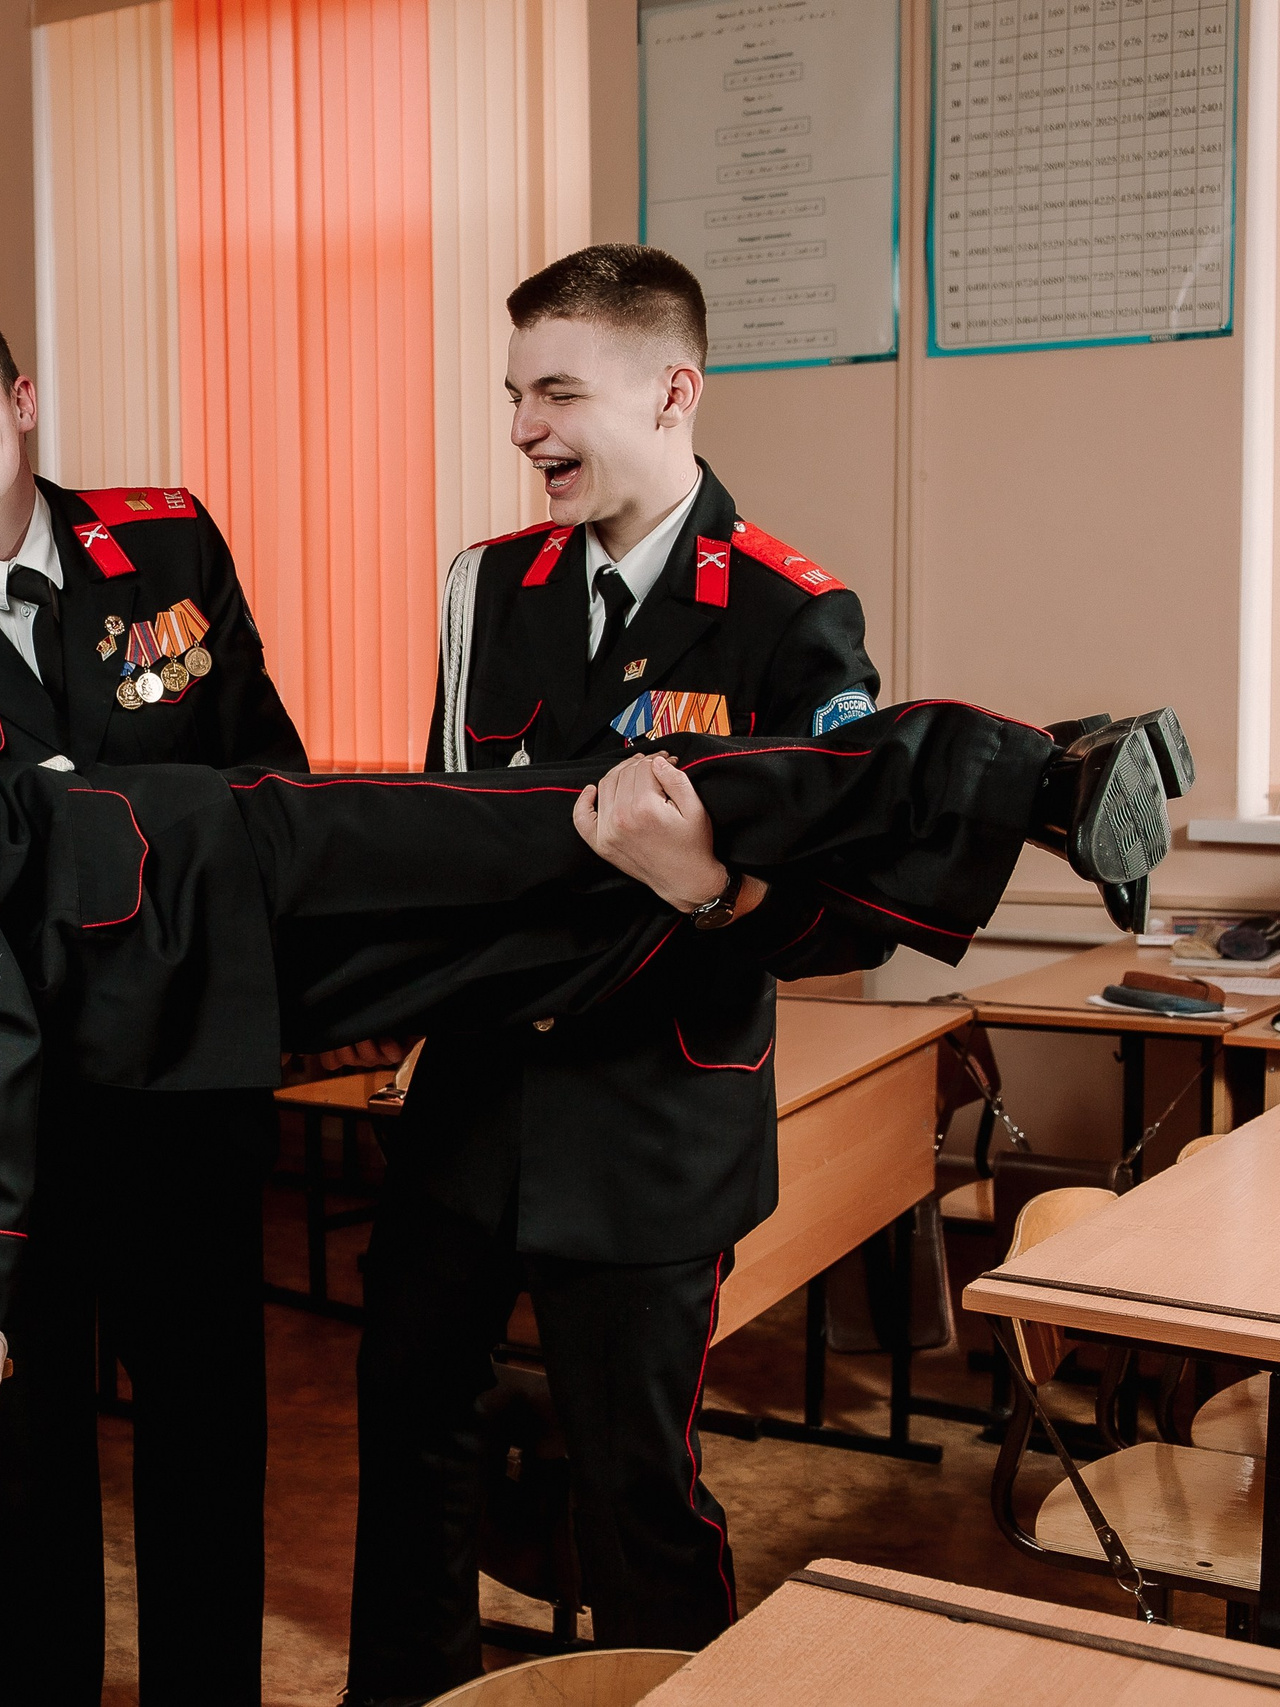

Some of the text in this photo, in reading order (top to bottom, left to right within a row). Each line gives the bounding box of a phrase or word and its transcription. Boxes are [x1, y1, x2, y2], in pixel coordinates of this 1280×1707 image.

[166, 489, 186, 509] НК
[800, 569, 832, 586] НК
[838, 700, 867, 712] РОССИЯ
[839, 710, 866, 722] КАДЕТС
